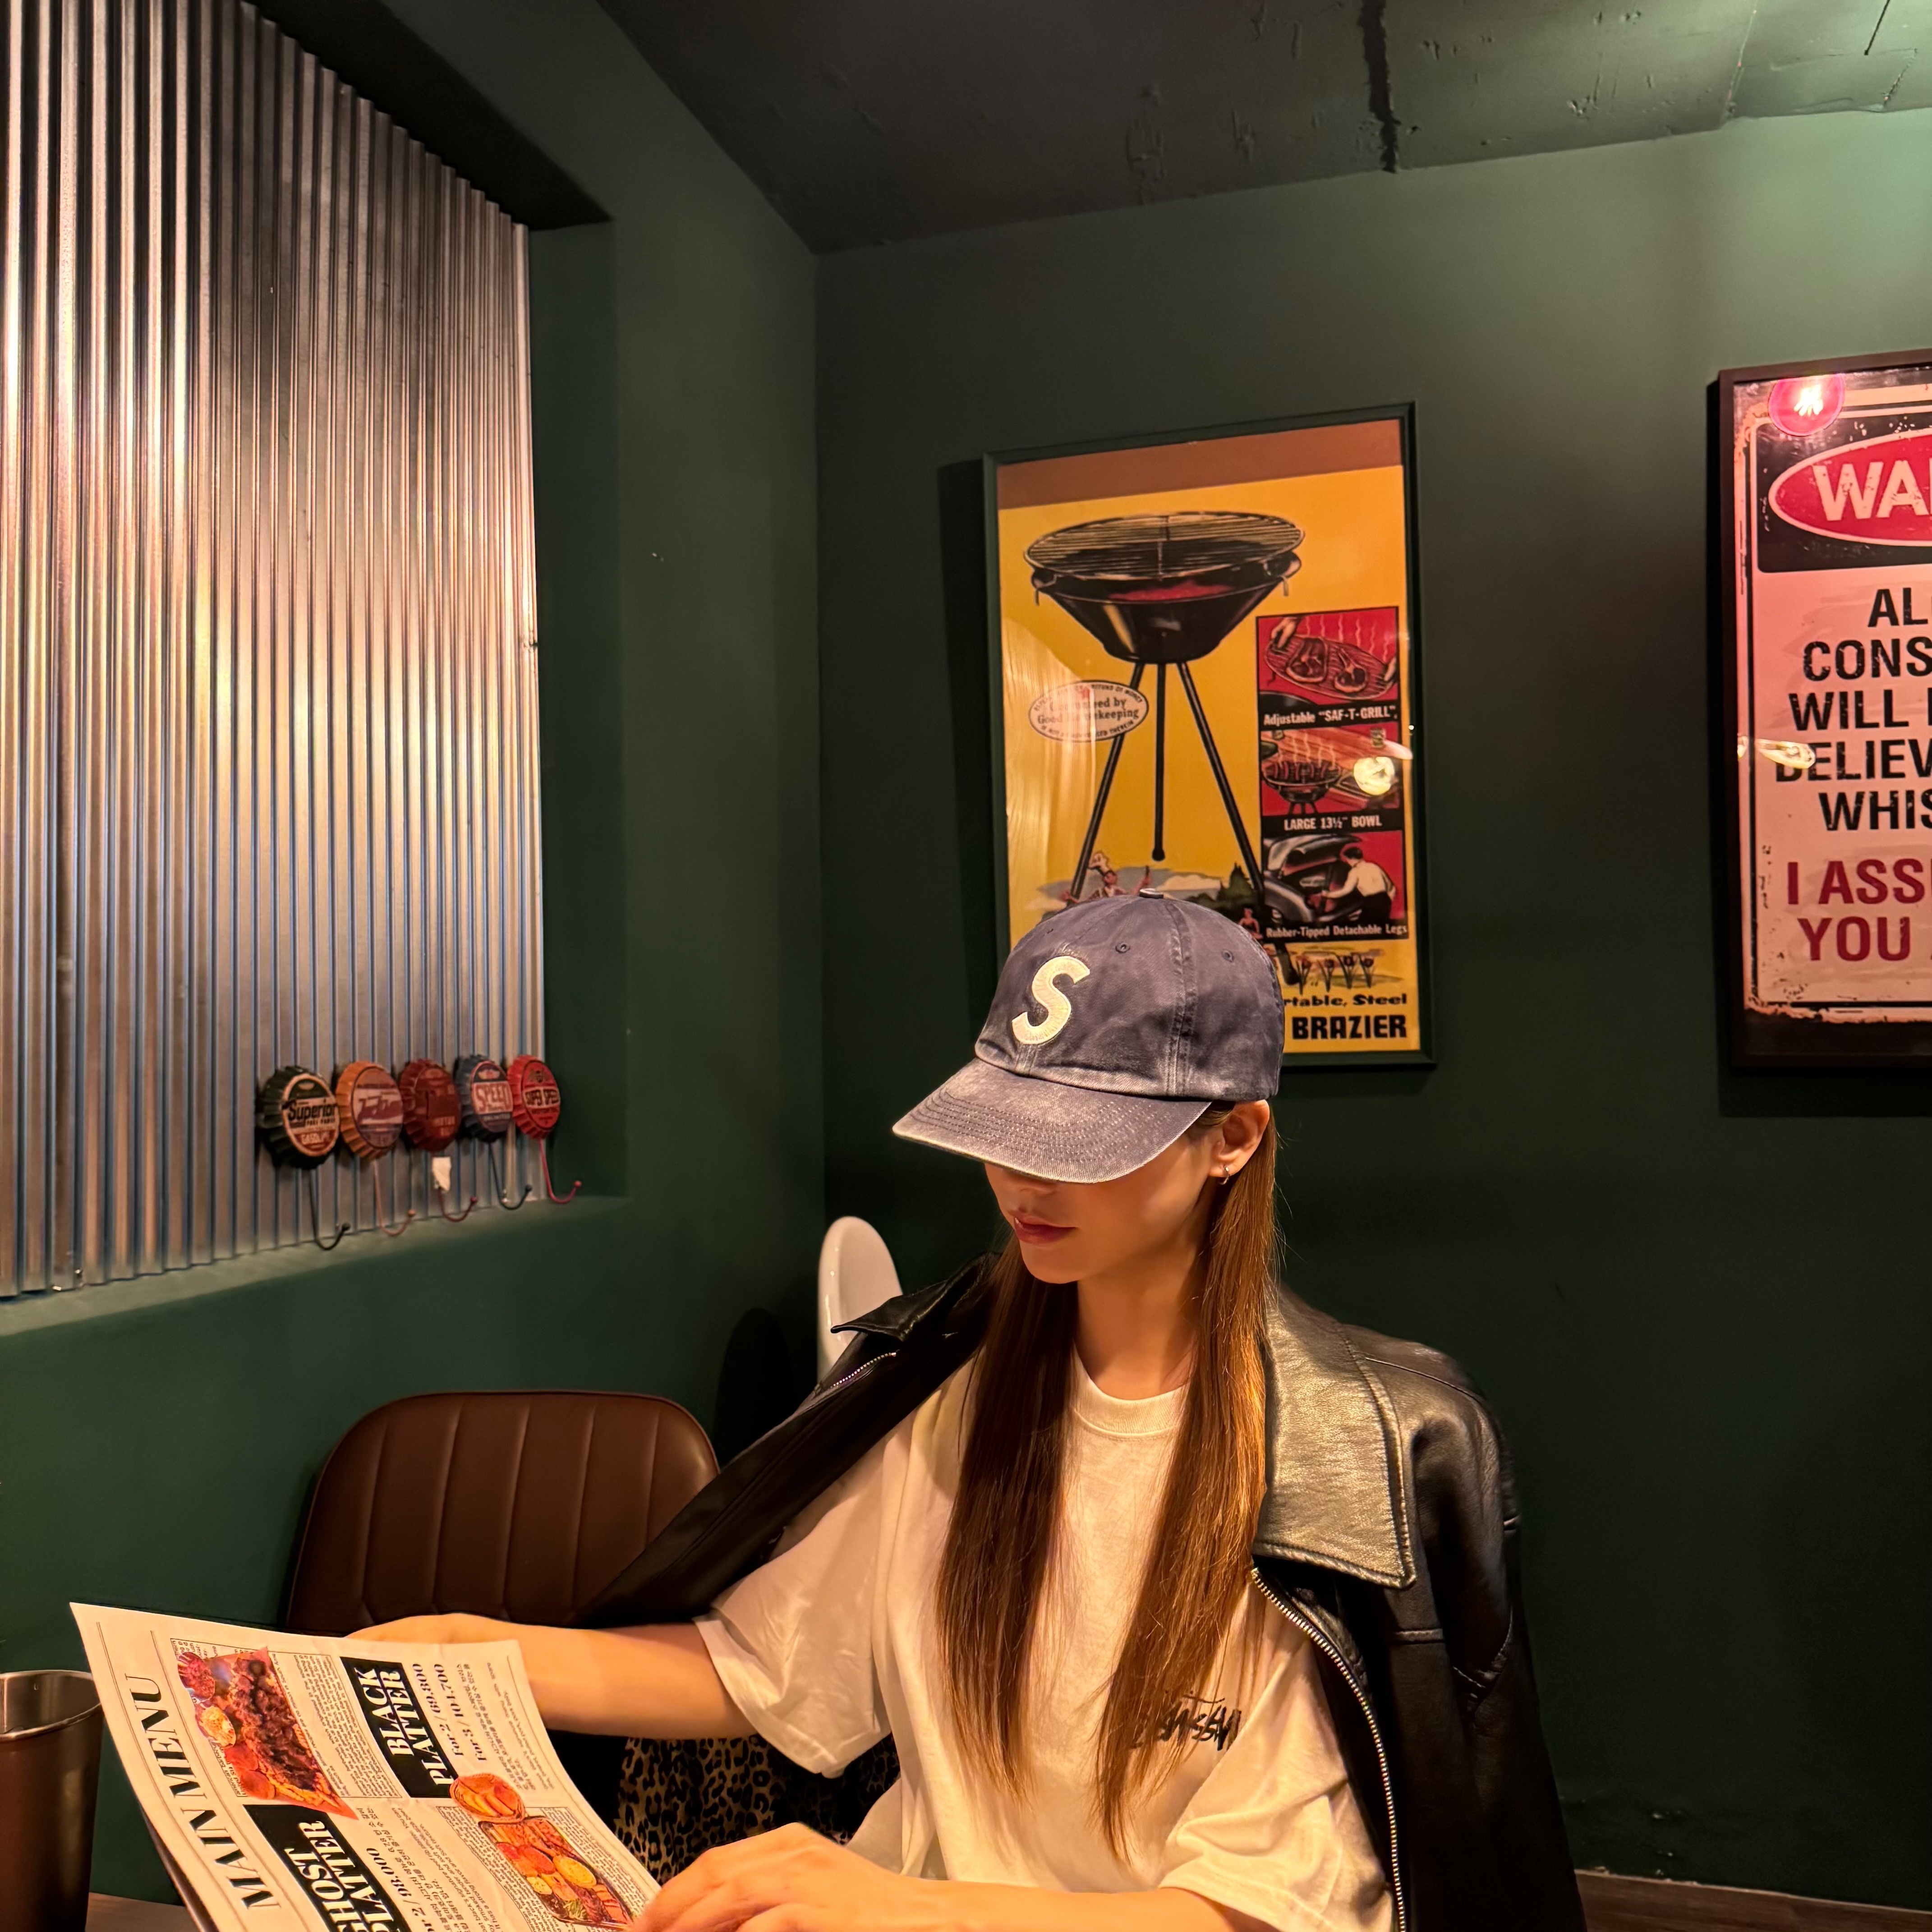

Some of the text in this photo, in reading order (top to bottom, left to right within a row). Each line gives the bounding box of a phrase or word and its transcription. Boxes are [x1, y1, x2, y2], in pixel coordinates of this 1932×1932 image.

[1812, 459, 1932, 521] WA
[1868, 587, 1932, 628] AL
[1114, 698, 1127, 708] by
[1789, 689, 1909, 731] WILL
[1264, 711, 1315, 727] Adjustable
[1284, 818, 1316, 831] LARGE
[1352, 814, 1382, 828] BOWL
[1787, 859, 1932, 905] I ASS
[1333, 925, 1381, 936] Detachable
[1385, 924, 1408, 936] Legs
[1798, 916, 1910, 961] YOU
[1012, 955, 1090, 1045] S
[1353, 993, 1407, 1005] Steel
[1292, 1015, 1407, 1040] BRAZIER
[281, 1099, 338, 1122] Superior
[353, 1667, 414, 1755] BLACK
[125, 1674, 207, 1799] MENU
[377, 1671, 455, 1785] PLATTER
[443, 1734, 464, 1756] For
[466, 1739, 487, 1760] For
[182, 1805, 281, 1910] MAIN
[442, 1864, 455, 1874] and
[440, 1872, 467, 1897] signature
[451, 1877, 471, 1894] tender
[466, 1885, 486, 1903] strong
[409, 1907, 426, 1916] 2
[467, 1897, 489, 1920] smoked
